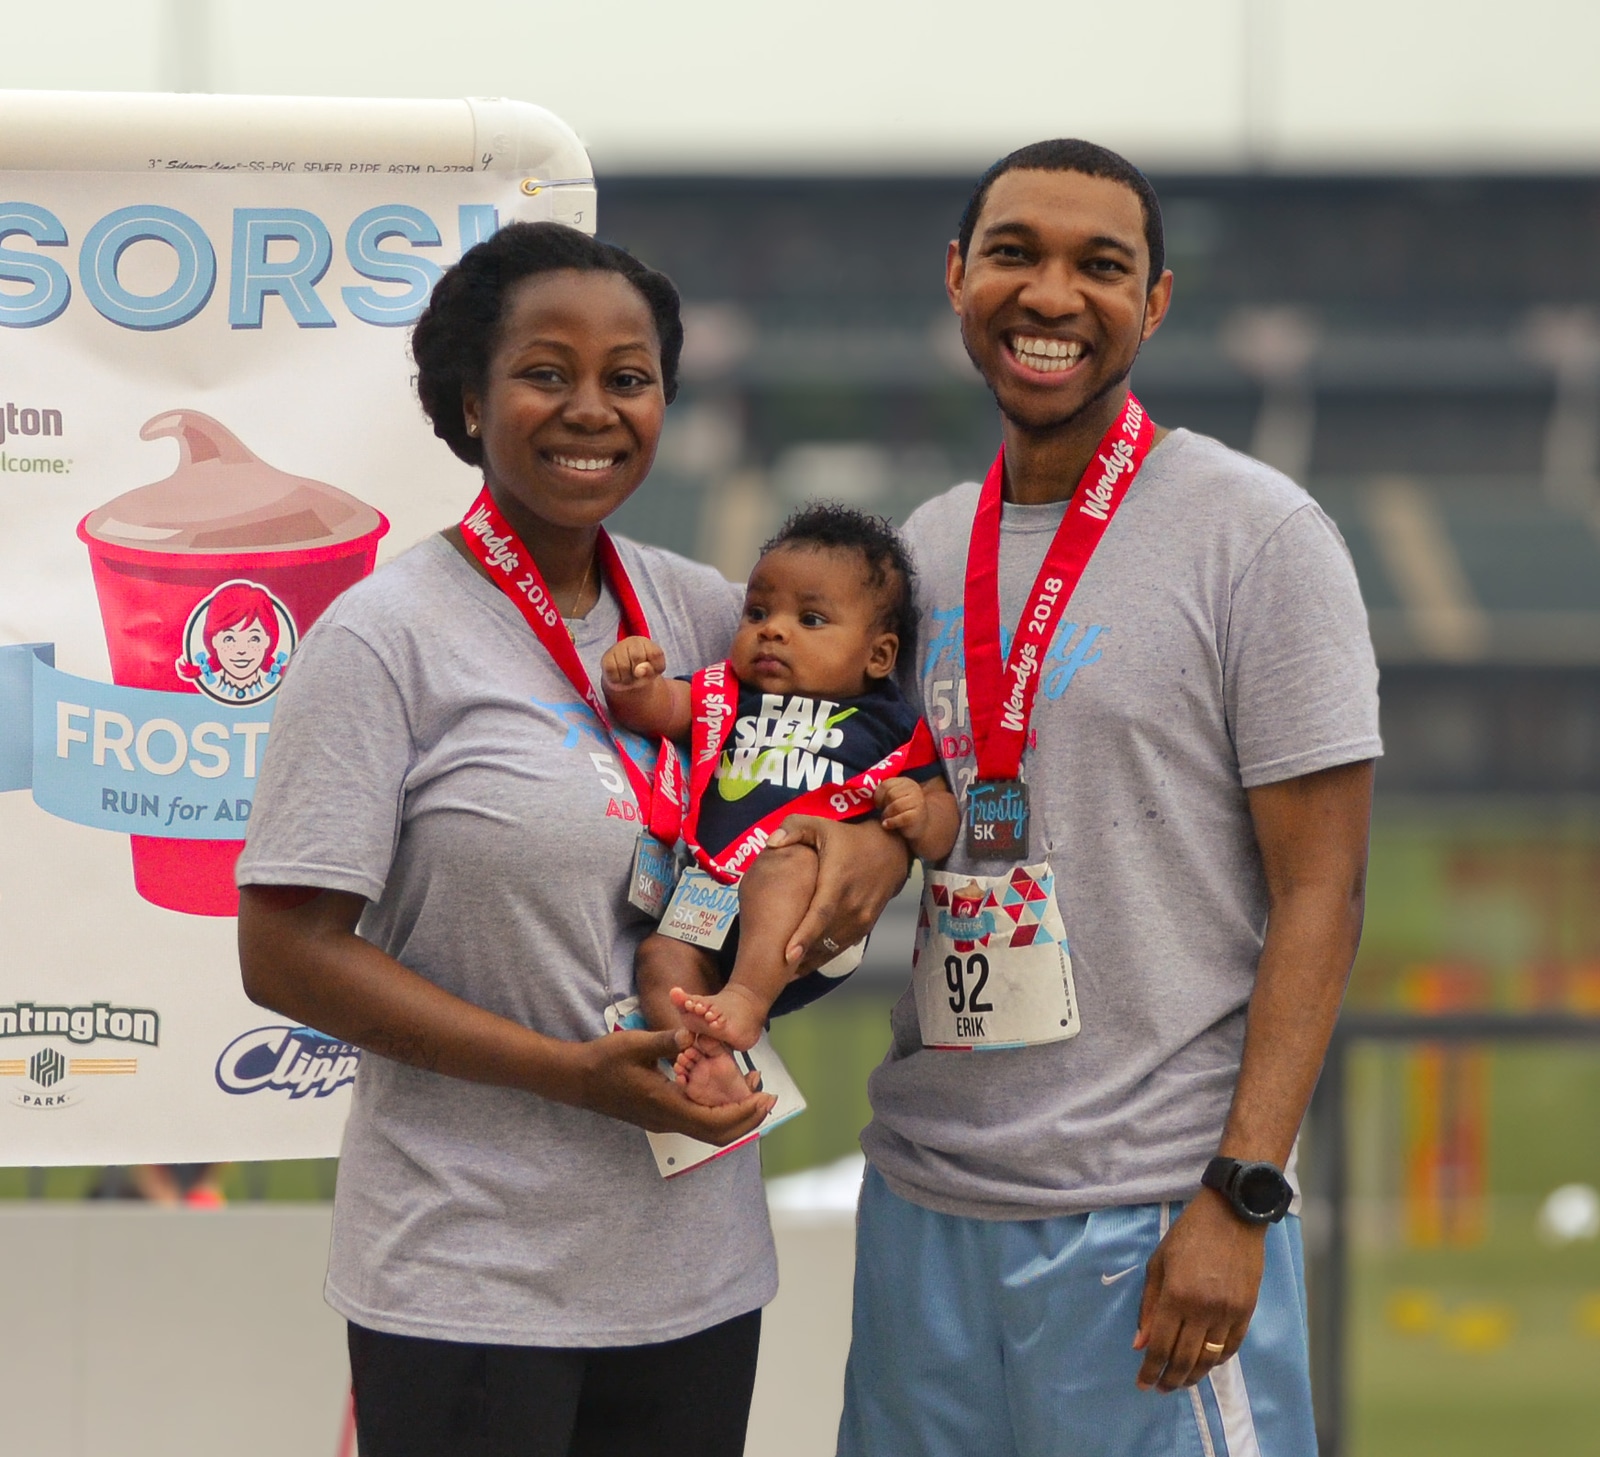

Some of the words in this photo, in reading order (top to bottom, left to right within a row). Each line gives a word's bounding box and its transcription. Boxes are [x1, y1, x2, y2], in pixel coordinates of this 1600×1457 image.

[1080, 438, 1137, 521] Wendy's
[1122, 398, 1144, 441] 2018
[463, 503, 519, 575] Wendy's
[516, 573, 558, 627] 2018
[1001, 642, 1038, 732] Wendy's
[1029, 577, 1063, 636] 2018
[735, 716, 844, 754] SLEEP
[101, 787, 159, 817] RUN
[165, 795, 206, 826] for
[967, 784, 1029, 839] Frosty
[974, 824, 995, 840] 5K
[638, 874, 654, 896] 5K
[674, 868, 740, 931] Frosty
[669, 919, 711, 937] ADOPTION
[673, 906, 698, 925] 5K
[699, 911, 718, 922] RUN
[680, 931, 698, 942] 2018
[944, 953, 993, 1014] 92
[957, 1016, 986, 1038] ERIK
[23, 1093, 67, 1107] PARK
